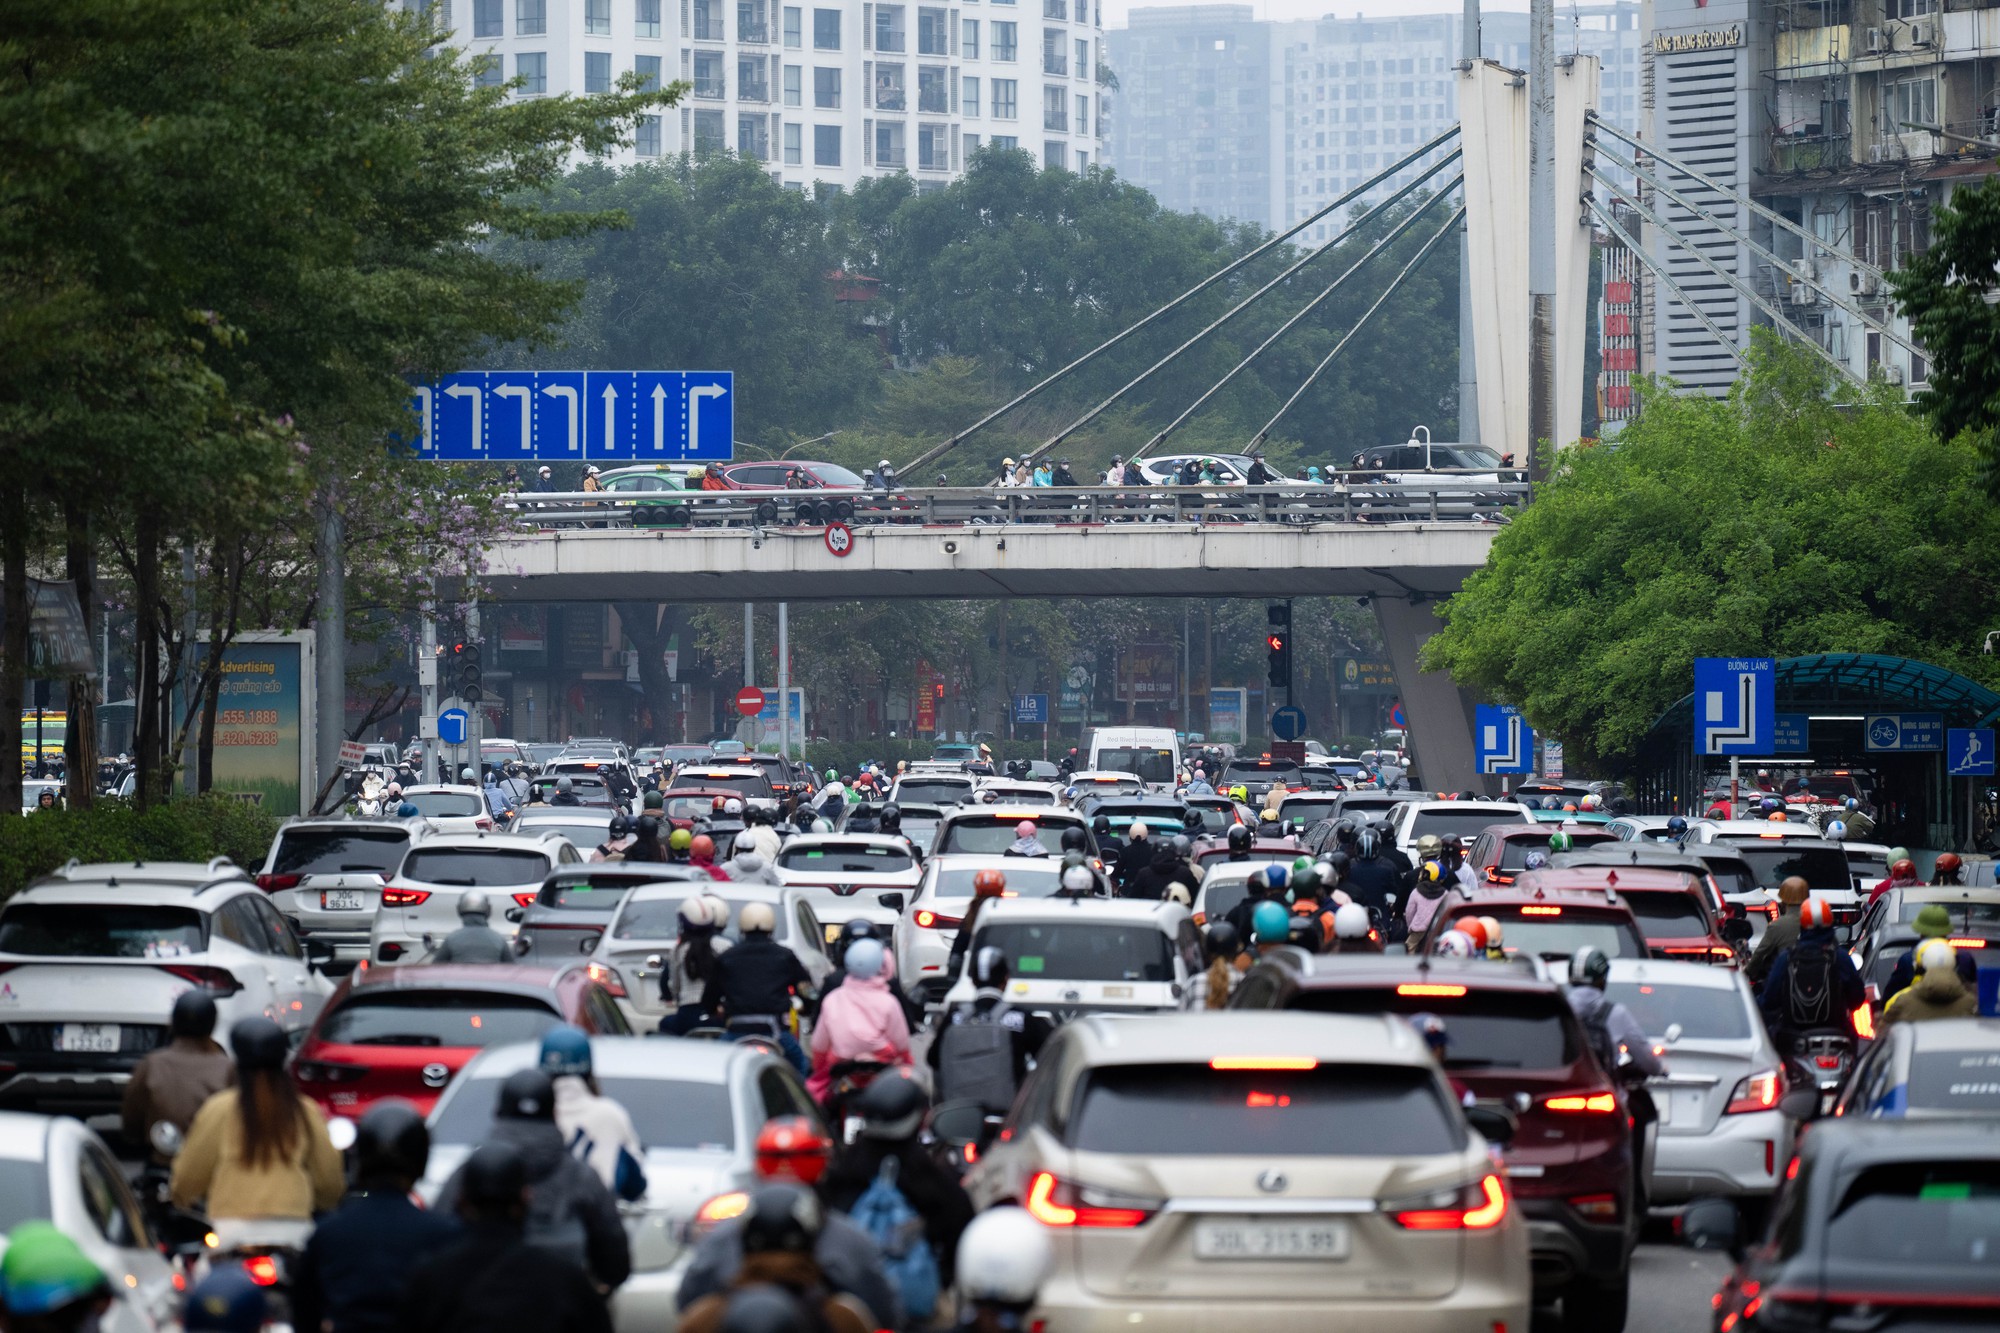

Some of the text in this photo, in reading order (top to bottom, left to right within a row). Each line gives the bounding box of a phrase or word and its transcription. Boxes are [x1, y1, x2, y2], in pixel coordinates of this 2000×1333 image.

[1673, 33, 1696, 51] TRANG
[1697, 30, 1710, 48] SỨC
[1711, 31, 1725, 47] CAO
[220, 661, 275, 675] Advertising
[1727, 659, 1769, 671] ĐƯỜNG LÁNG
[231, 678, 261, 696] quảng
[262, 679, 282, 693] cáo
